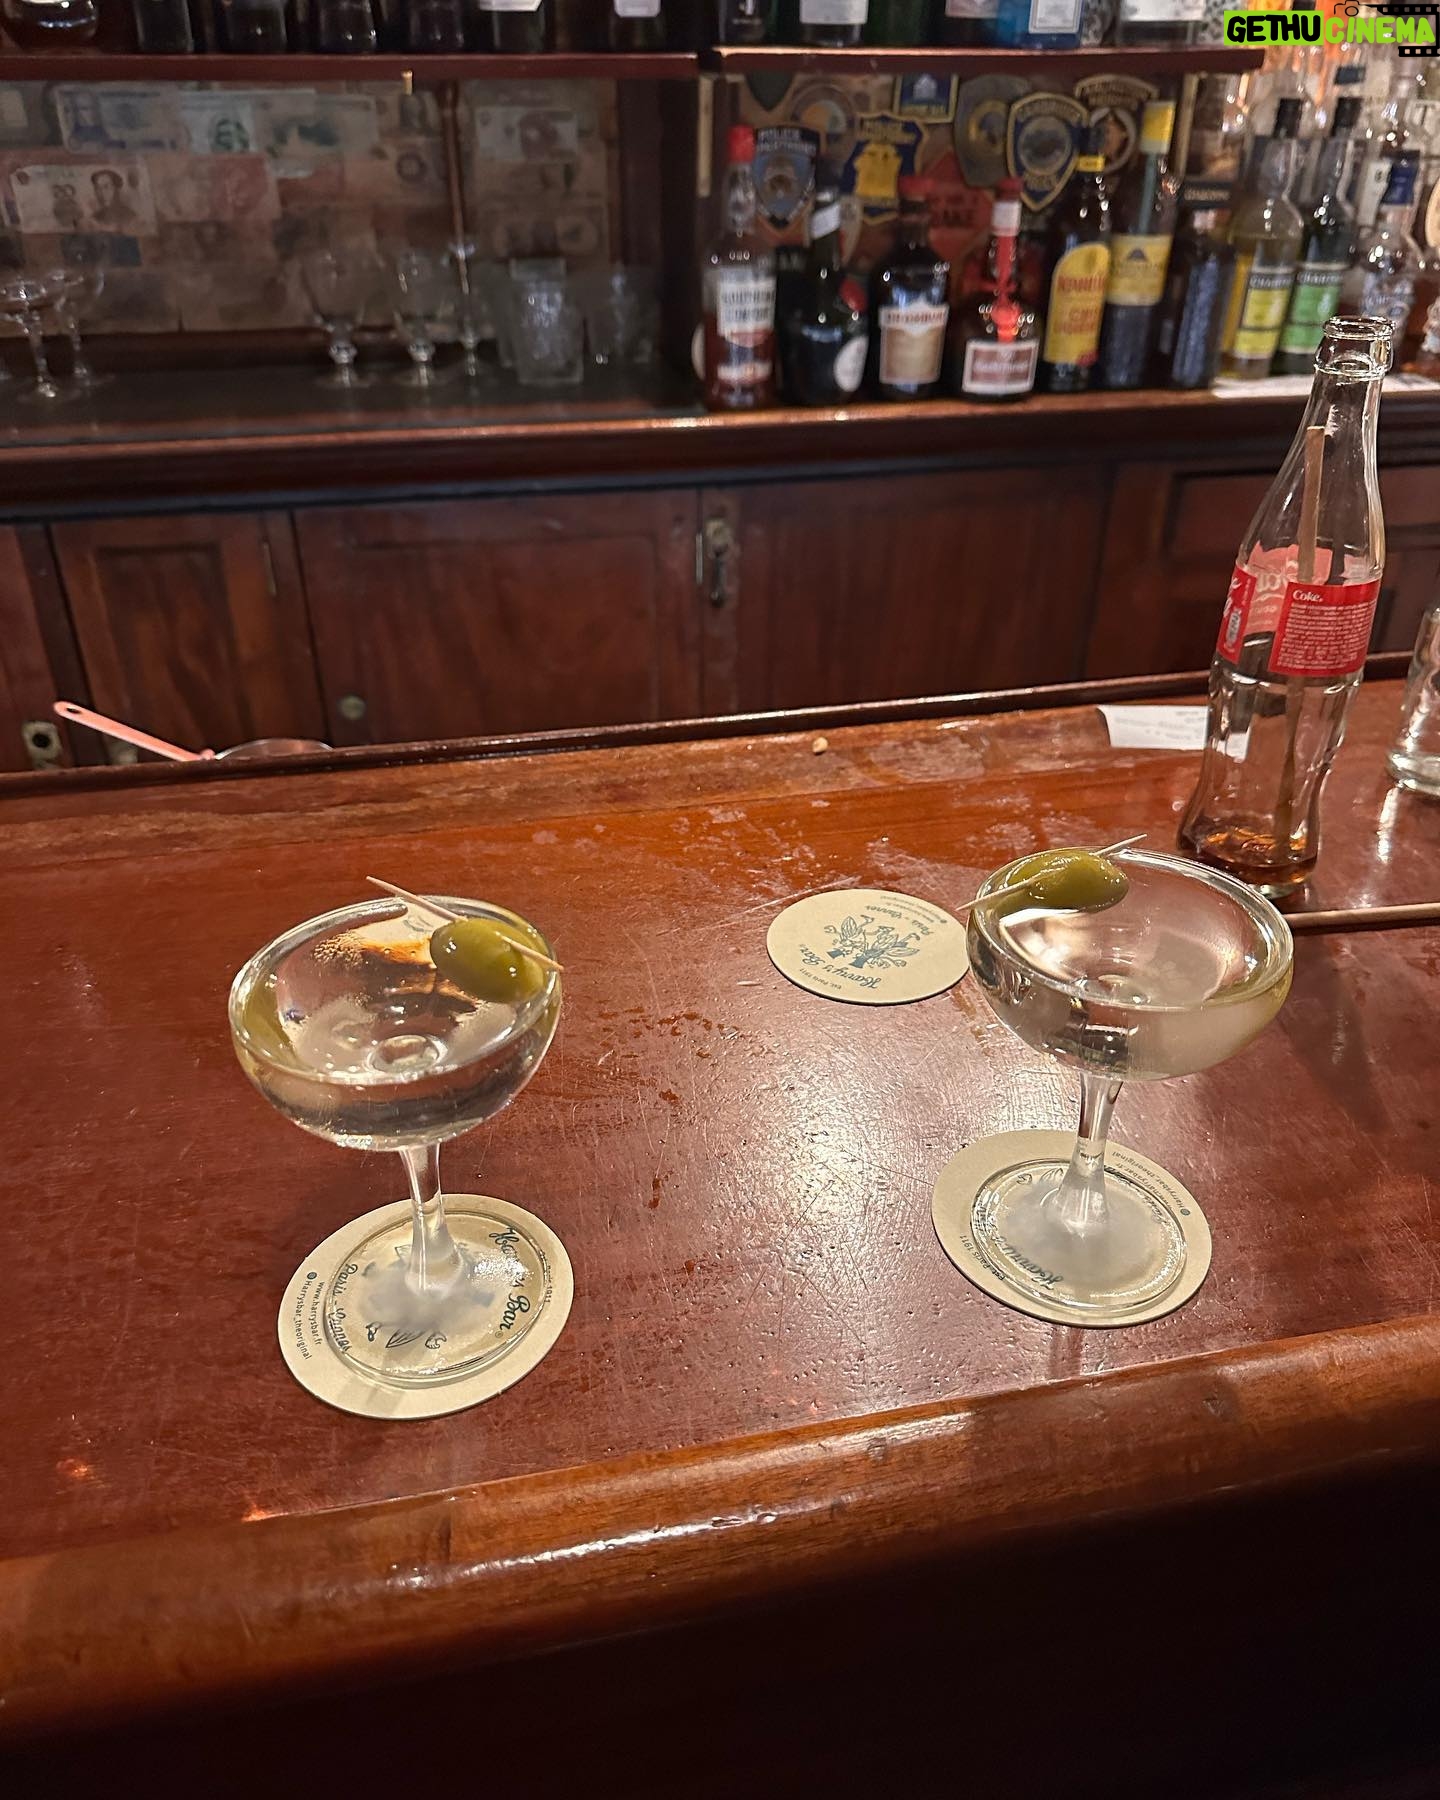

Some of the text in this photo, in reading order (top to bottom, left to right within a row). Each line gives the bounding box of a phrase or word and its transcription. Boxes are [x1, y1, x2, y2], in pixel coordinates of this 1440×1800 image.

[960, 1236, 974, 1252] 1911
[293, 1280, 313, 1360] Harrysbar_theoriginal
[309, 1281, 325, 1345] www.harrysbar.fr
